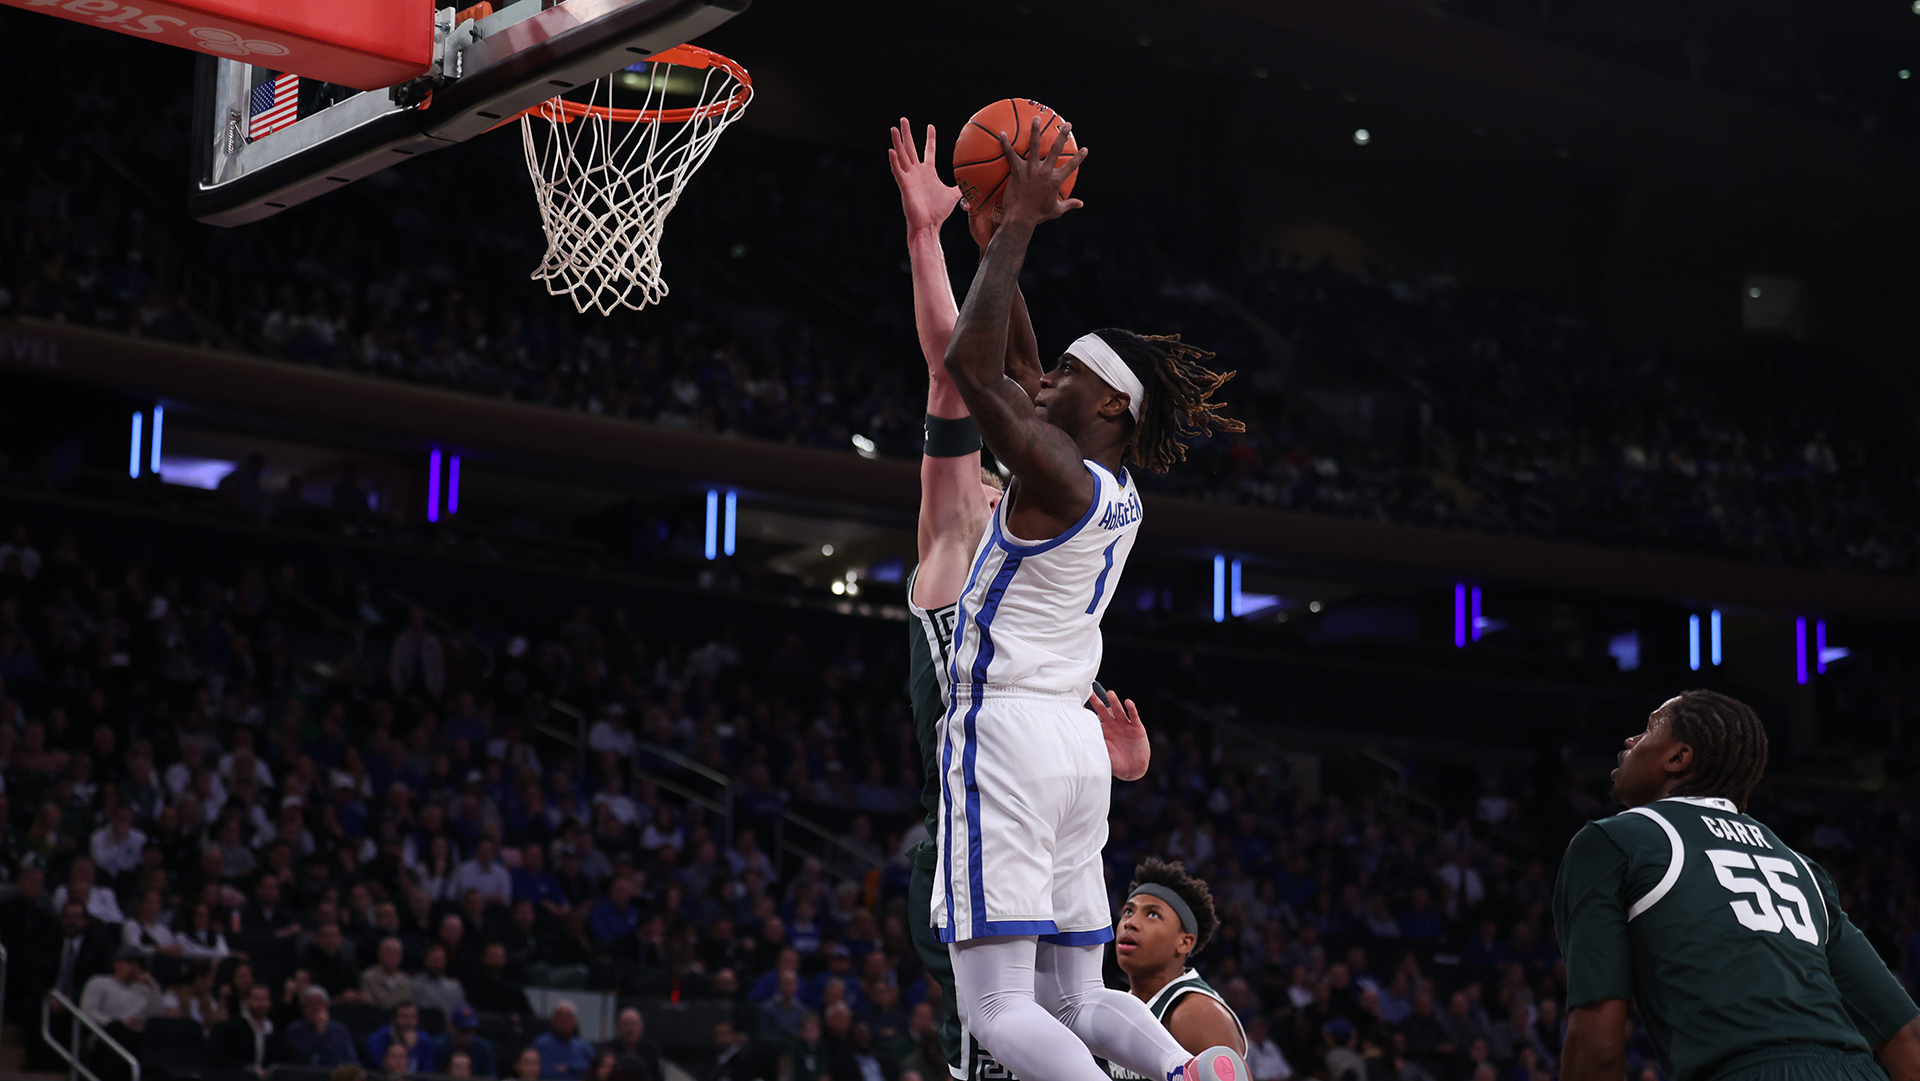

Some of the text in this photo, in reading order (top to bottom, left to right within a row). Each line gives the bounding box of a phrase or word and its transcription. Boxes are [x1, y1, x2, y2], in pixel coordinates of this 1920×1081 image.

[1085, 535, 1122, 615] 1
[1701, 815, 1773, 850] CARR
[1704, 849, 1819, 946] 55
